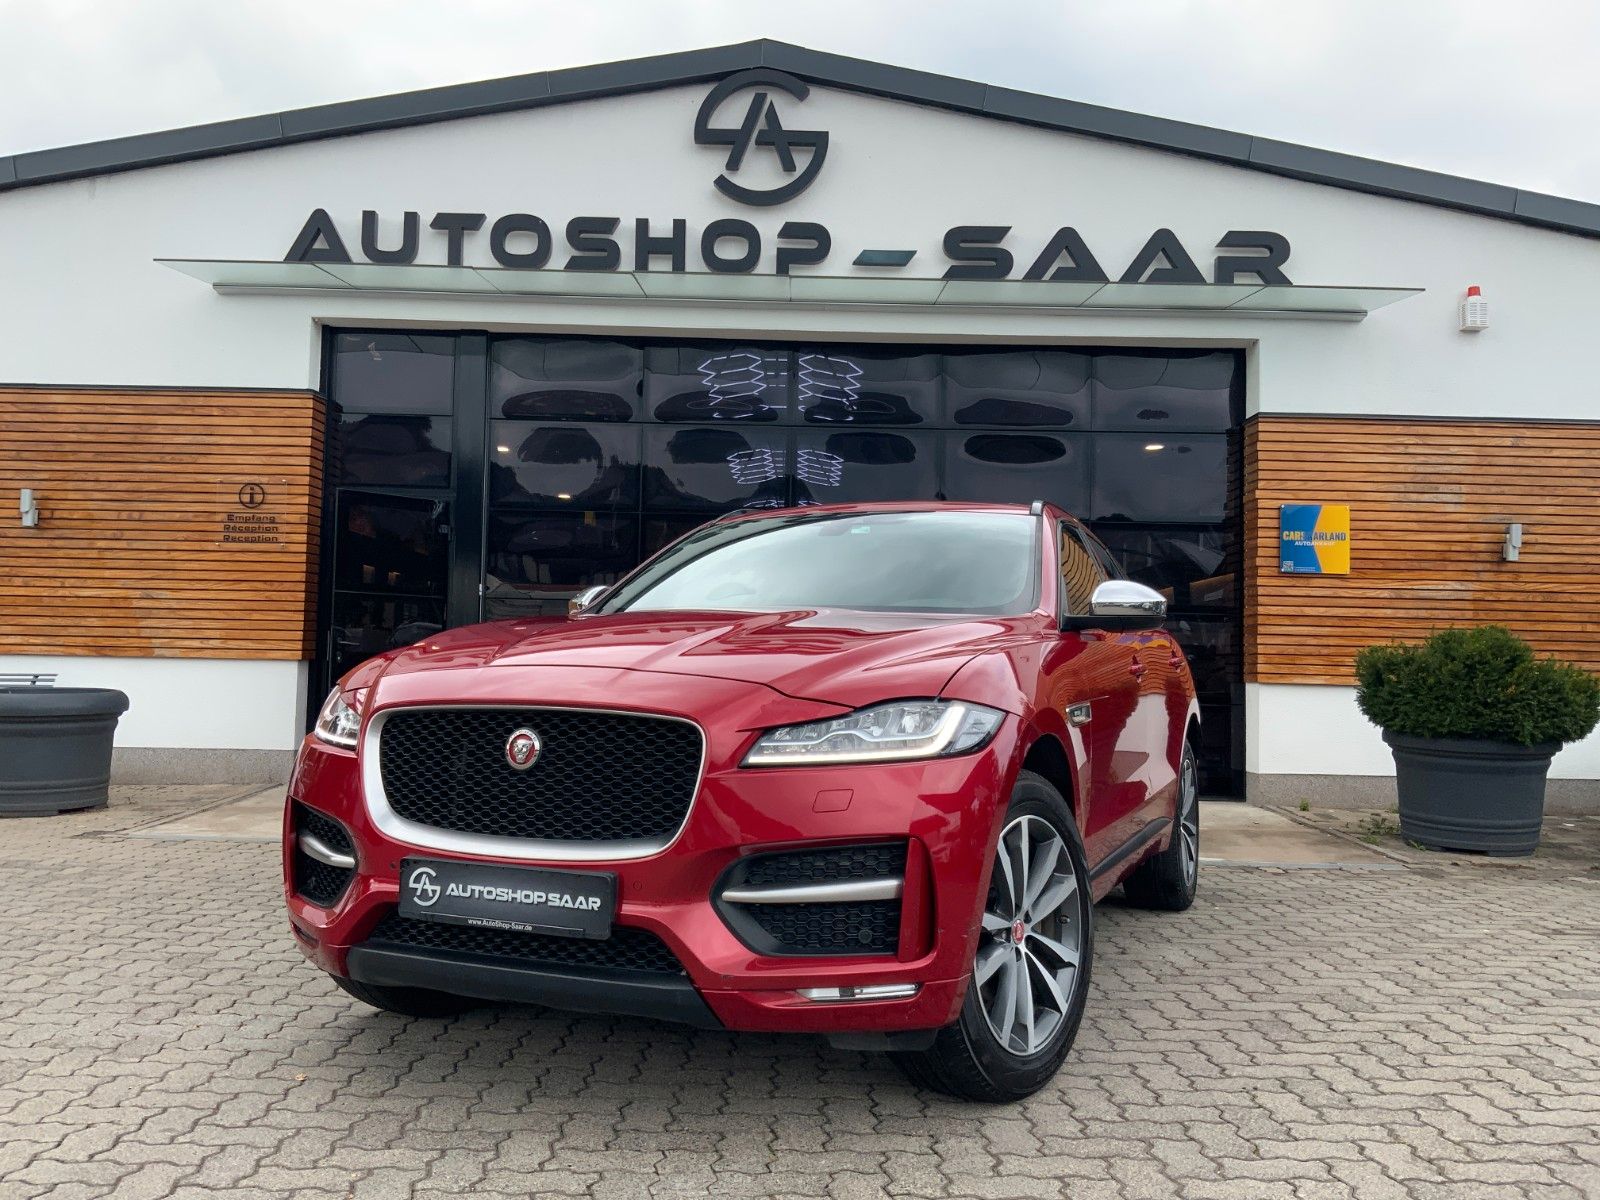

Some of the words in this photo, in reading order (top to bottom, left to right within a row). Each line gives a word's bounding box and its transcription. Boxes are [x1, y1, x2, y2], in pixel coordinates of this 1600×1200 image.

[284, 208, 832, 275] AUTOSHOP
[943, 226, 1293, 285] SAAR
[227, 514, 276, 523] Empfang
[467, 918, 533, 931] www.AutoShop-Saar.de
